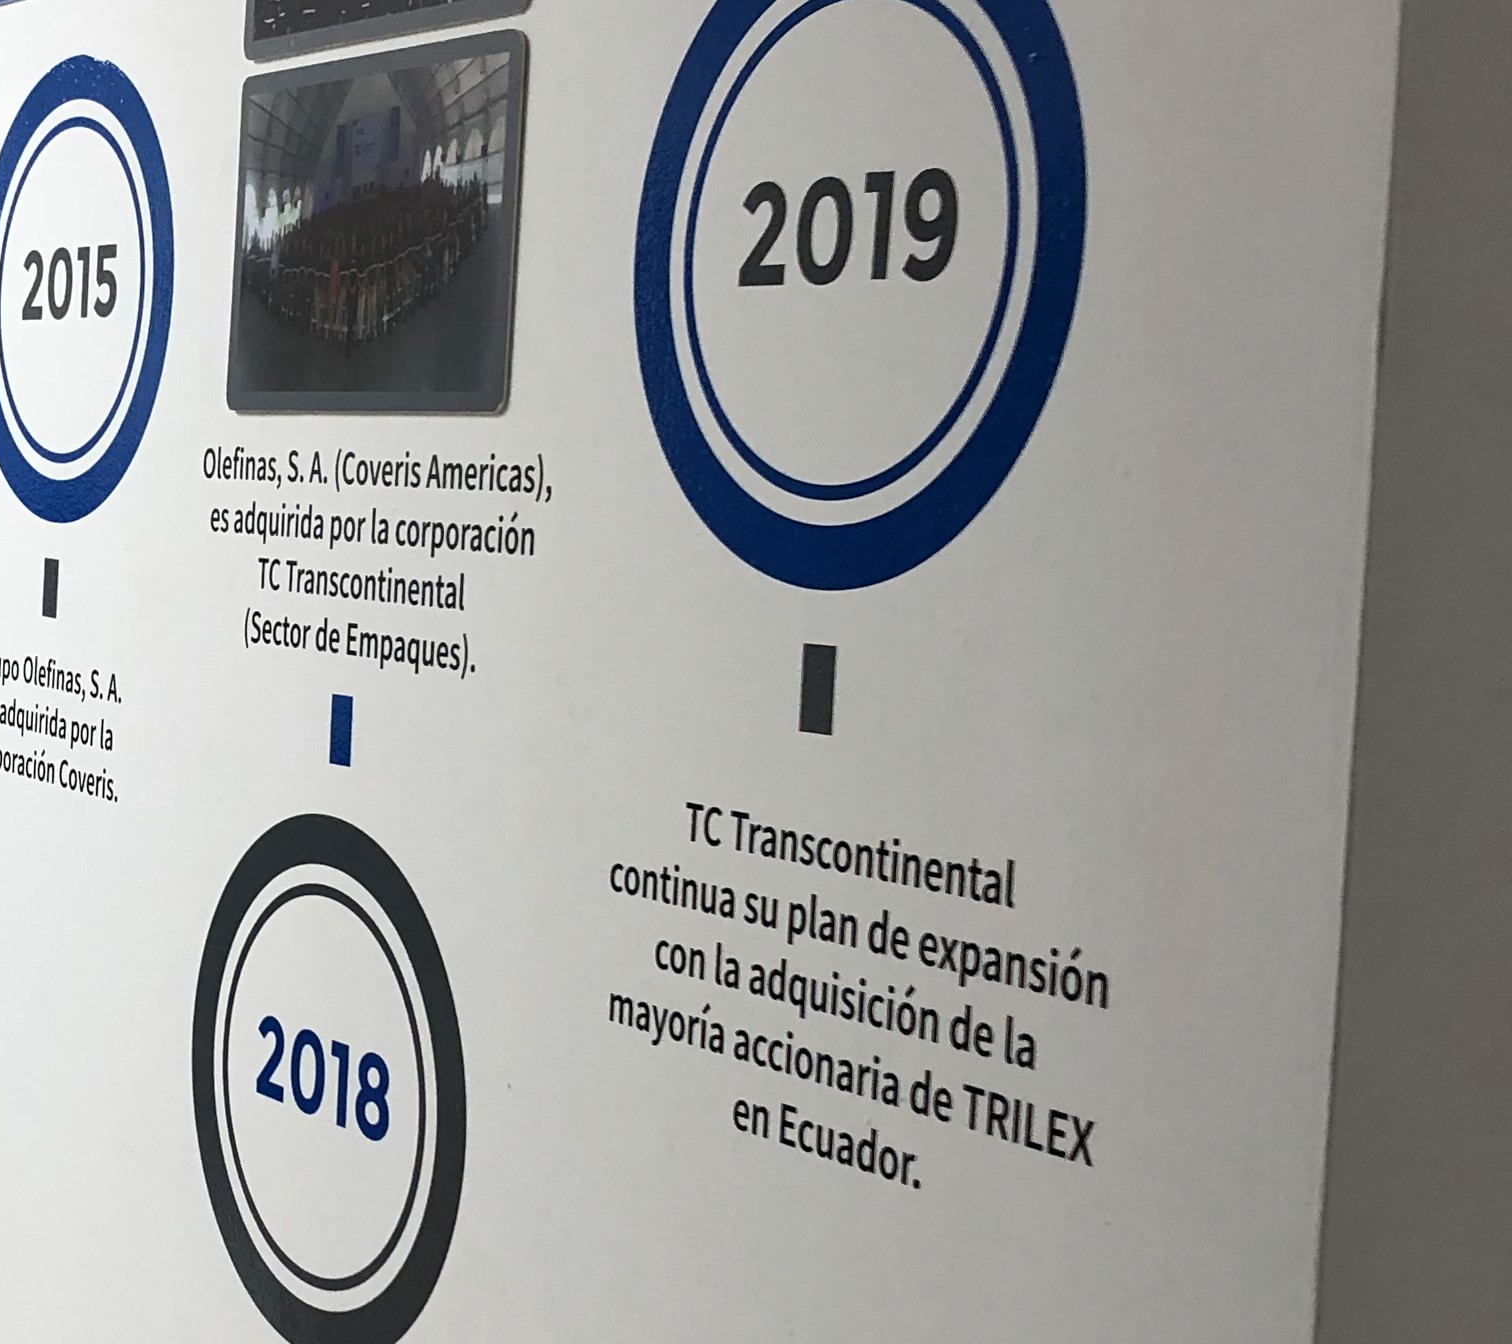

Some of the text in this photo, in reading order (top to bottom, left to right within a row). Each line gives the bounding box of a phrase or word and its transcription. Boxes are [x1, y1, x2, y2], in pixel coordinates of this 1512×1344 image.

[739, 167, 959, 287] 2019
[22, 244, 118, 321] 2015
[203, 446, 552, 503] Olefinas, S. A. (Coveris Americas),
[210, 501, 535, 558] es adquirida por la corporación
[258, 558, 464, 611] TC Transcontinental
[23, 656, 85, 703] Olefinas,
[90, 669, 103, 700] S.
[107, 673, 121, 704] A.
[245, 607, 475, 680] (Sector de Empaques).
[0, 698, 67, 739] adquirida
[70, 721, 97, 749] por
[100, 719, 113, 751] la
[59, 759, 118, 802] Coveris.
[686, 802, 1016, 909] TC Transcontinental
[610, 863, 1110, 1009] continua su plan de expansión
[655, 940, 1038, 1071] con la adquisición de la
[256, 1015, 390, 1141] 2018
[609, 993, 1097, 1167] mayoría accionaria de TRILEX
[733, 1100, 921, 1189] en Ecuador.
